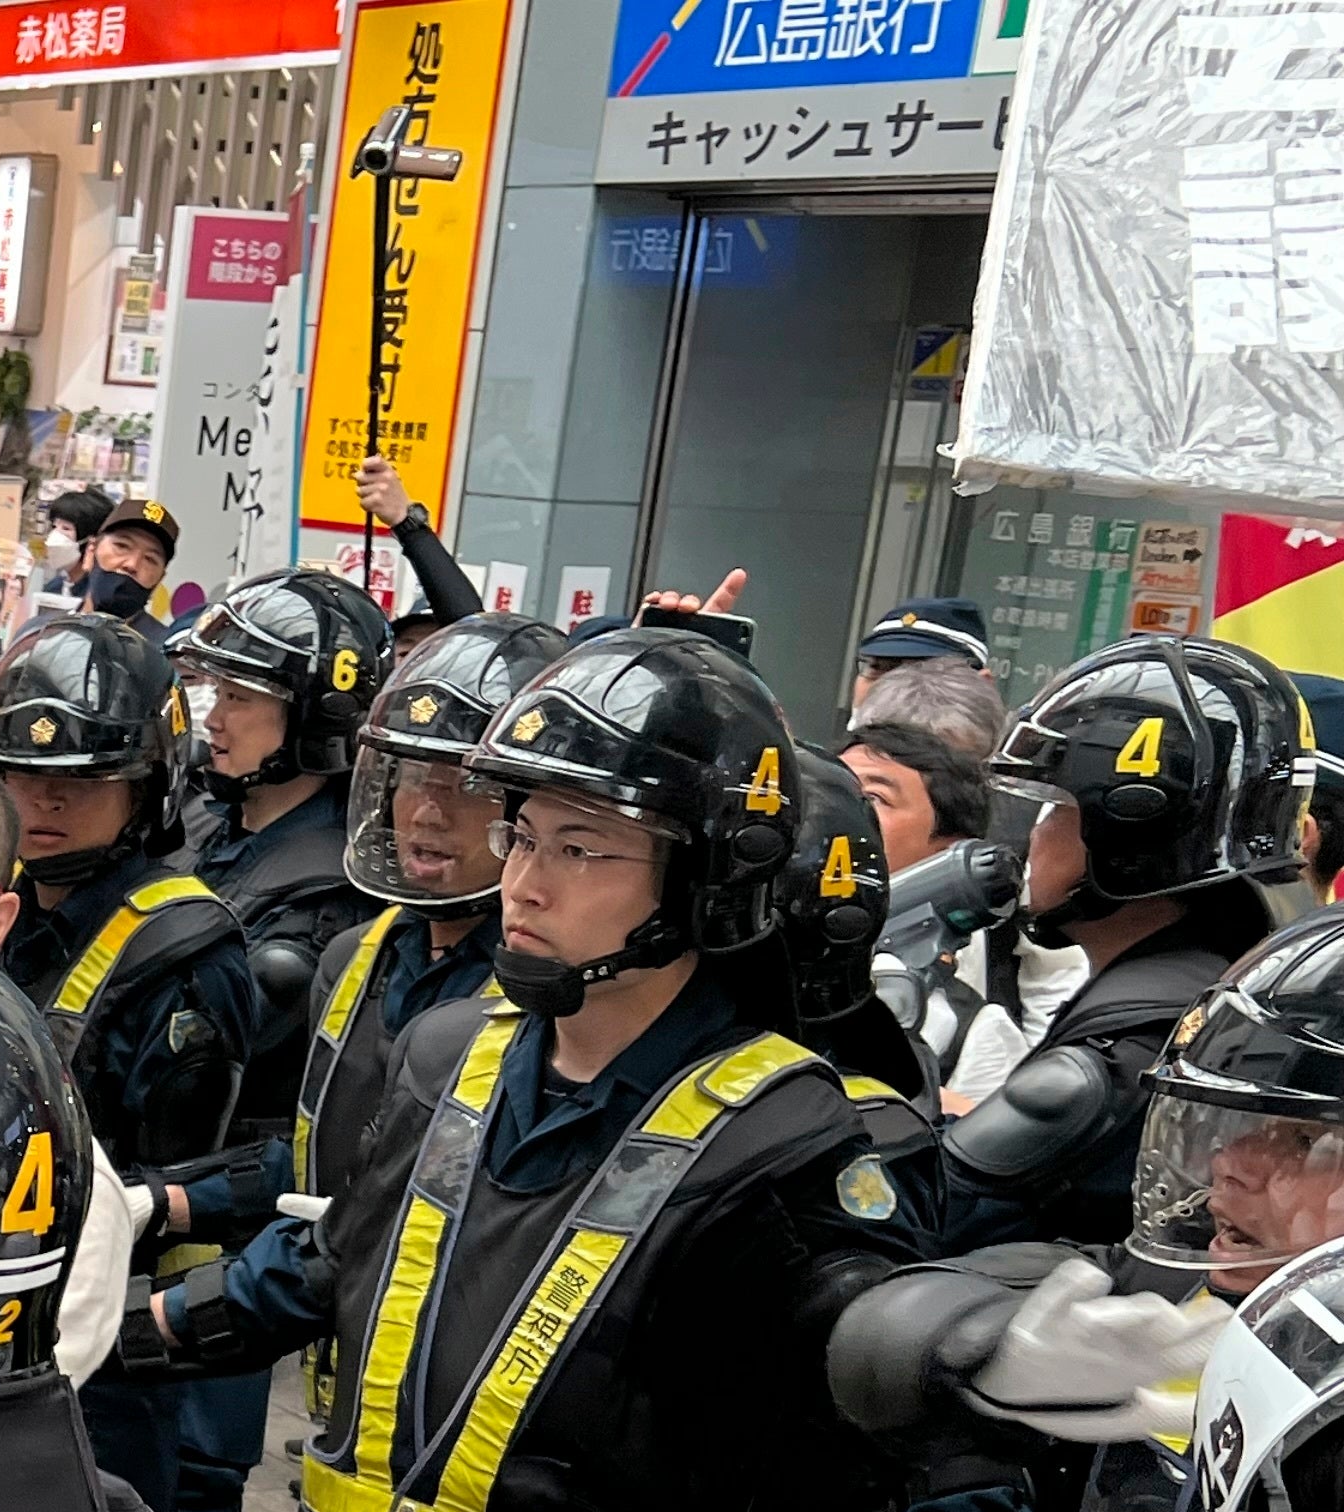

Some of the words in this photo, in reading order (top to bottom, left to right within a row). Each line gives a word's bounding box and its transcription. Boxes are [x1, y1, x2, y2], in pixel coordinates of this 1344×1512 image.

[15, 7, 127, 64] 赤松薬局
[714, 0, 942, 67] 広島銀行
[208, 262, 278, 286] 階段から
[211, 237, 282, 261] こちらの
[990, 510, 1137, 553] 広島銀行
[332, 649, 358, 692] 6
[1115, 717, 1164, 778] 4
[746, 747, 788, 816] 4
[819, 836, 857, 899] 4
[0, 1131, 56, 1237] 4
[500, 1264, 589, 1386] 警視庁
